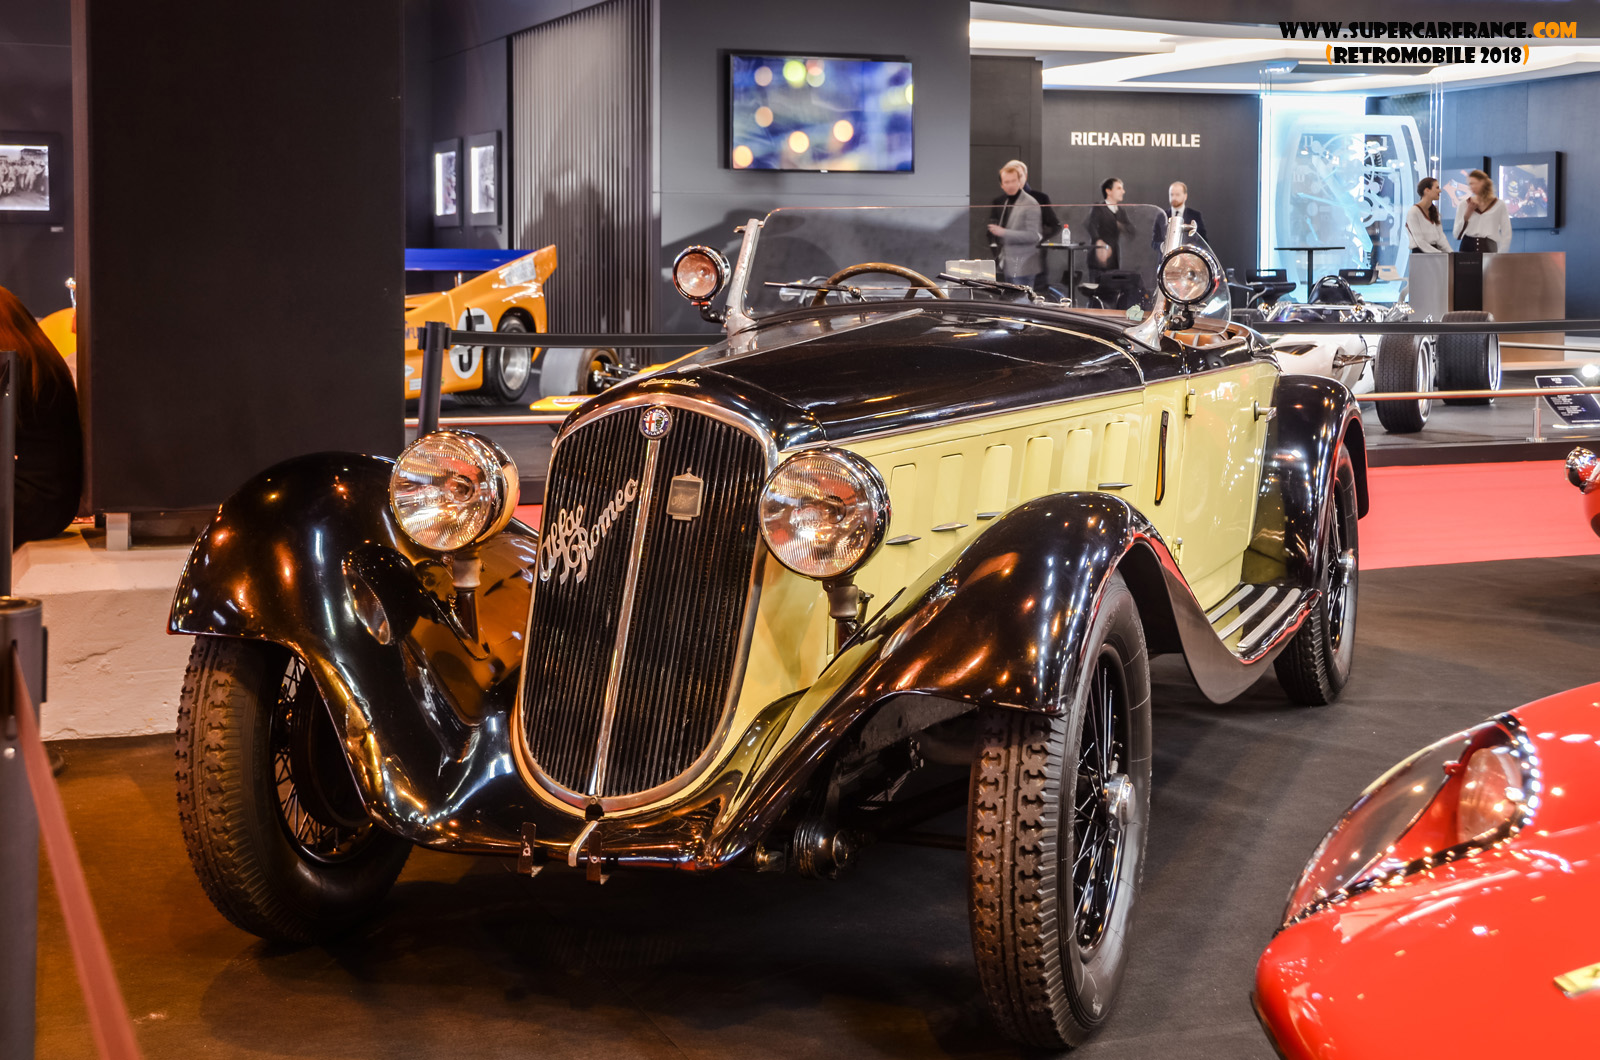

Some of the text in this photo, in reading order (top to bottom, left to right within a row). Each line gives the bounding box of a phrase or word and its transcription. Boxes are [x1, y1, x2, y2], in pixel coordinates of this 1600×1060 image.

[1071, 131, 1200, 147] RICHARD MILLE
[565, 478, 638, 584] Romeo
